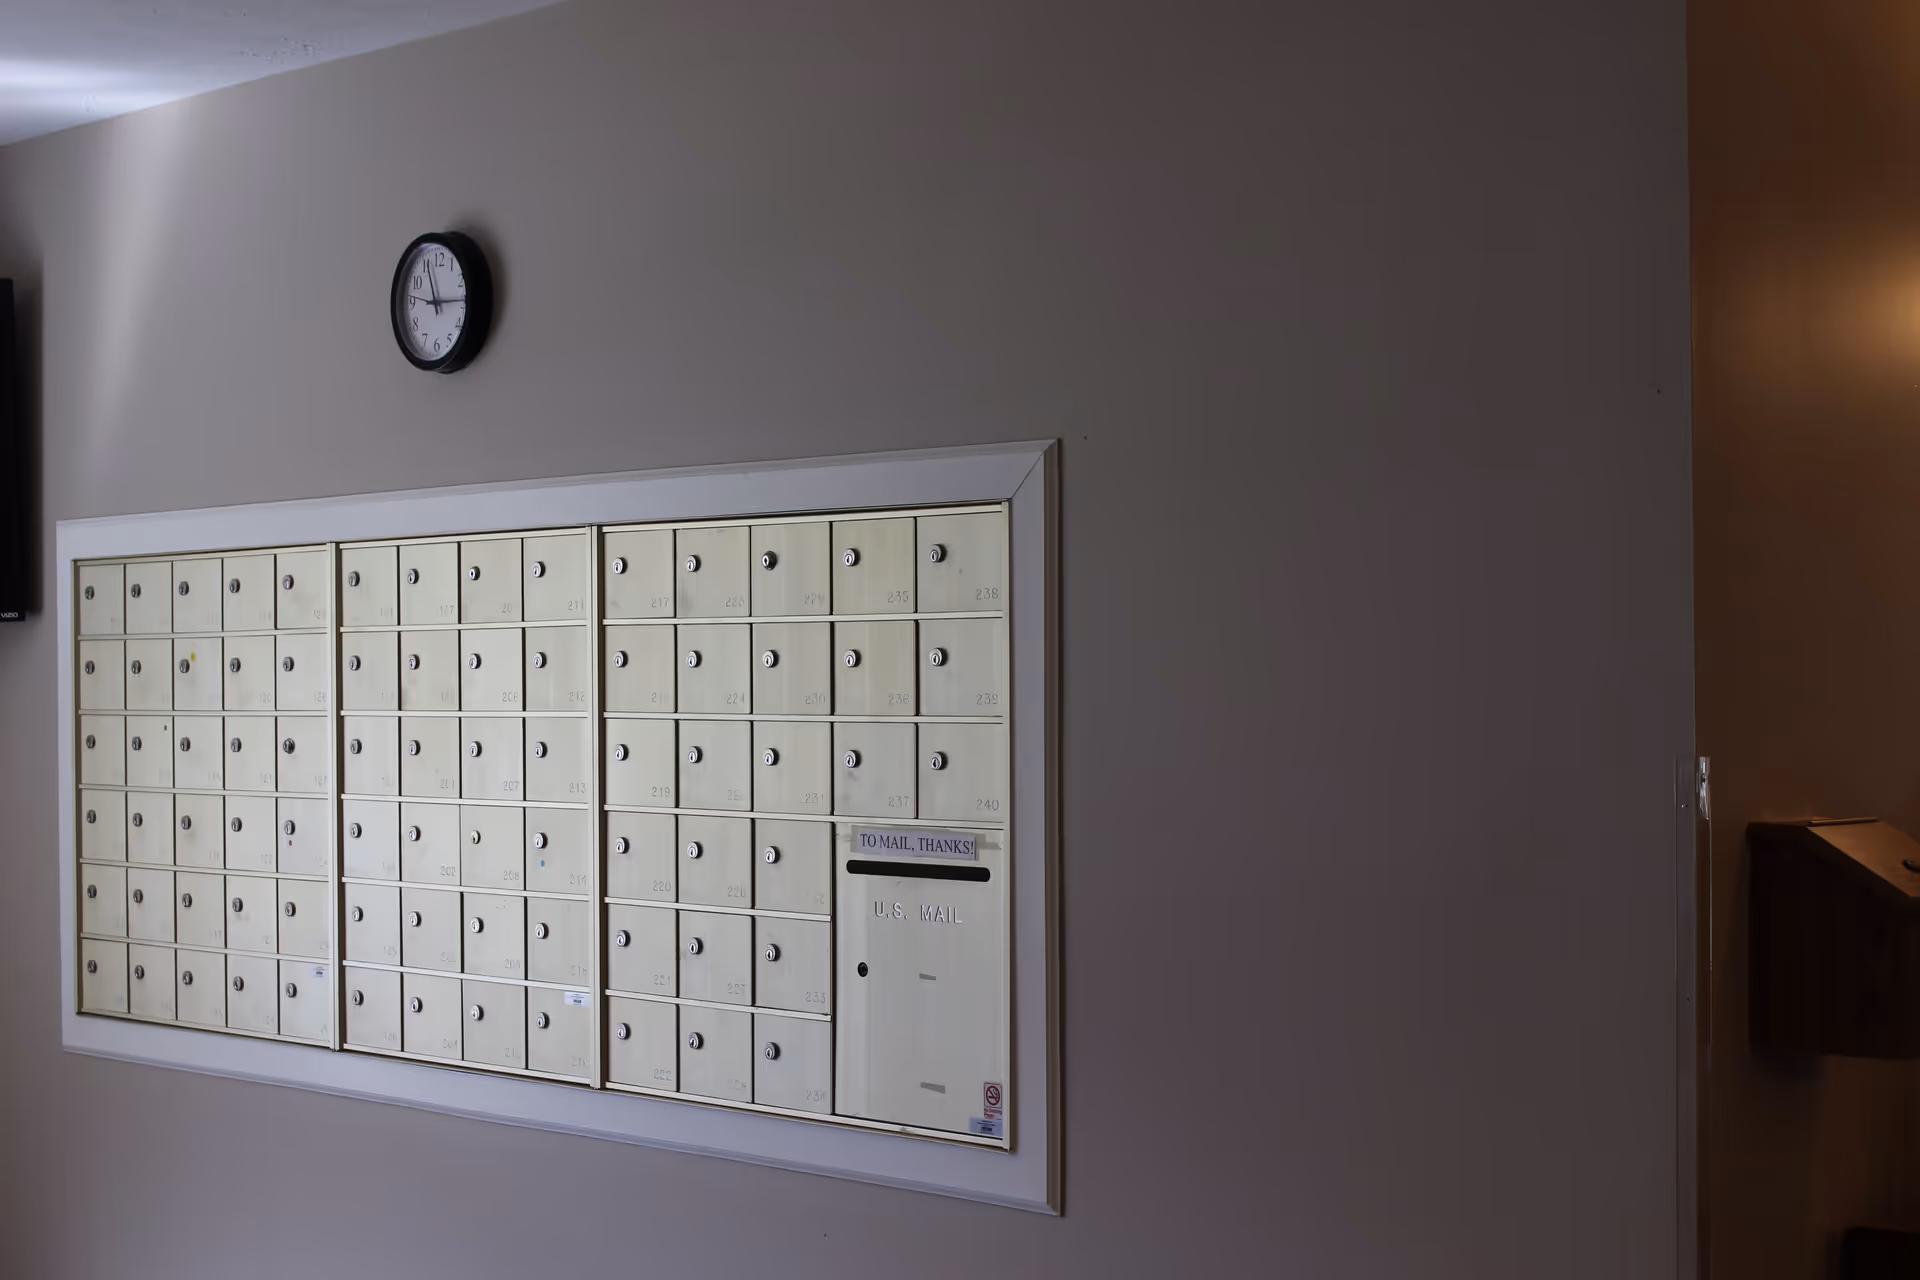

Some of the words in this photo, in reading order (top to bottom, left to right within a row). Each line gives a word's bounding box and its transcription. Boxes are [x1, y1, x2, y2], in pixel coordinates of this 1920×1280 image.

[434, 252, 445, 267] 12
[413, 275, 422, 290] 10
[409, 296, 416, 309] 9
[412, 317, 419, 332] 8
[455, 316, 463, 329] 4
[421, 332, 428, 347] 7
[433, 337, 441, 352] 6
[446, 333, 453, 348] 5
[887, 590, 910, 604] 235
[975, 587, 999, 601] 238
[651, 597, 669, 608] 217
[651, 786, 671, 798] 219
[888, 795, 910, 809] 237
[976, 798, 1000, 812] 240
[859, 833, 877, 848] TO
[879, 834, 915, 851] MAIL,
[917, 837, 975, 855] THANKS!
[874, 900, 908, 920] U.S.
[919, 904, 963, 924] MAIL
